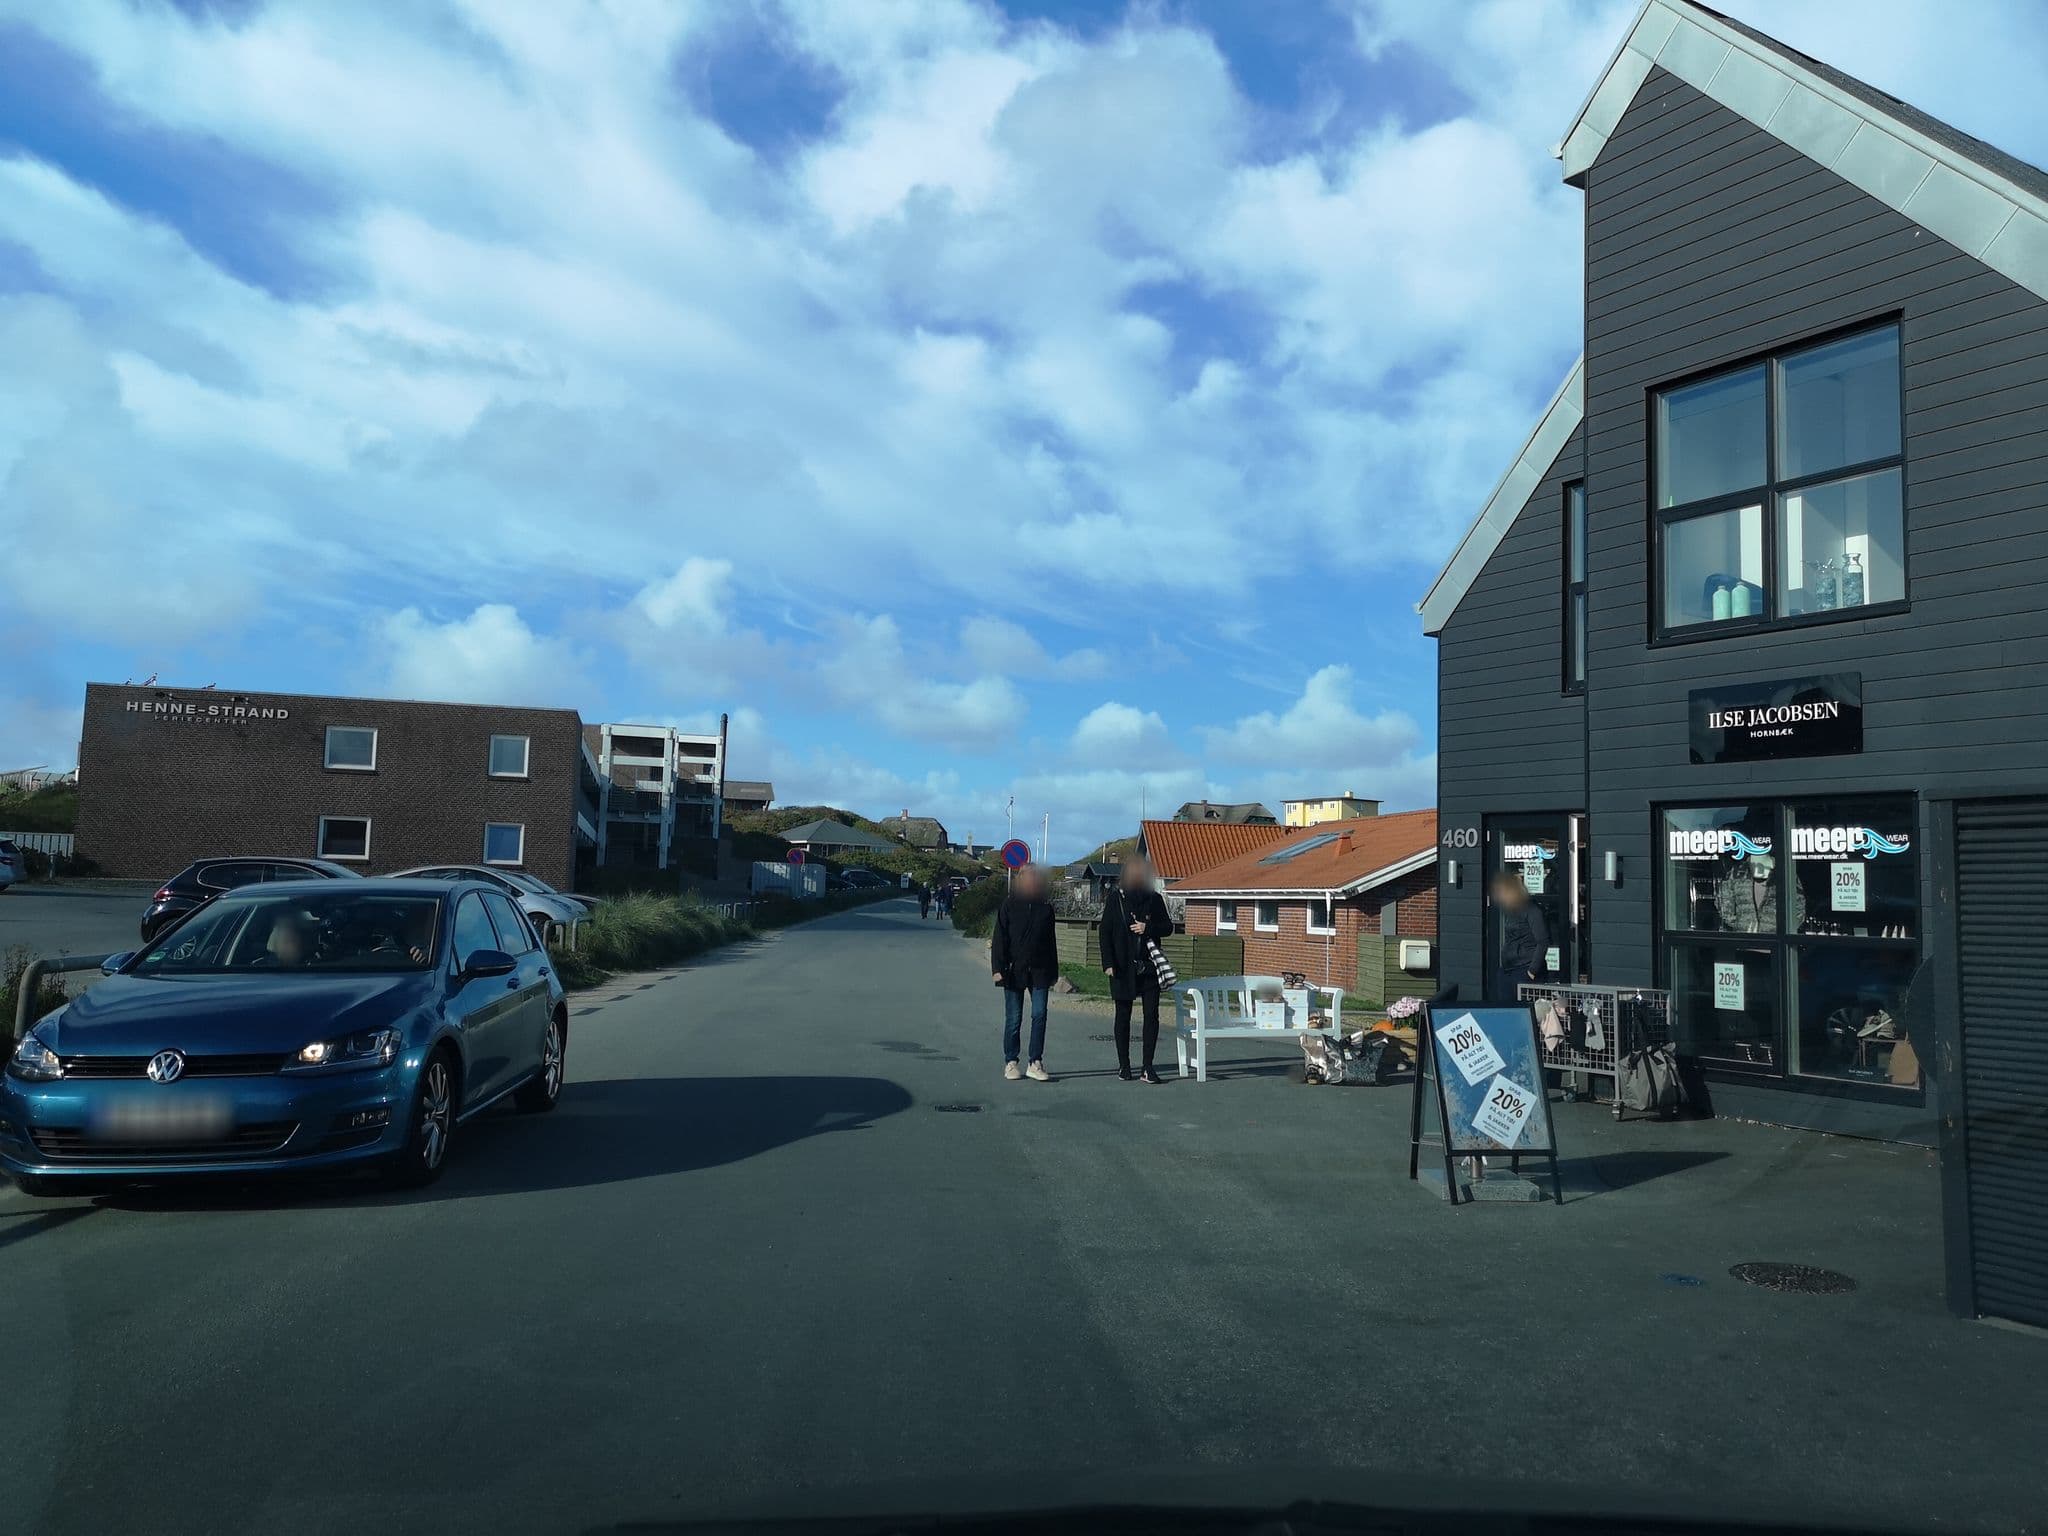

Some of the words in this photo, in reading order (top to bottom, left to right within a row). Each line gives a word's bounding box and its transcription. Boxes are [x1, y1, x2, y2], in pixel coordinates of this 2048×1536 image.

[126, 700, 289, 719] HENNE-STRAND
[1709, 709, 1745, 729] ILSE
[1747, 701, 1840, 728] JACOBSEN
[154, 715, 248, 725] FERIECENTER
[1750, 727, 1794, 738] HORNBÆK
[1442, 828, 1478, 848] 460
[1670, 829, 1735, 854] meer
[1752, 836, 1772, 844] WEAR
[1791, 826, 1865, 853] meer
[1886, 834, 1909, 842] WEAR
[1836, 872, 1861, 887] 20%
[1719, 972, 1740, 987] 20%
[1448, 1026, 1482, 1055] 20%
[1491, 1088, 1527, 1119] 20%
